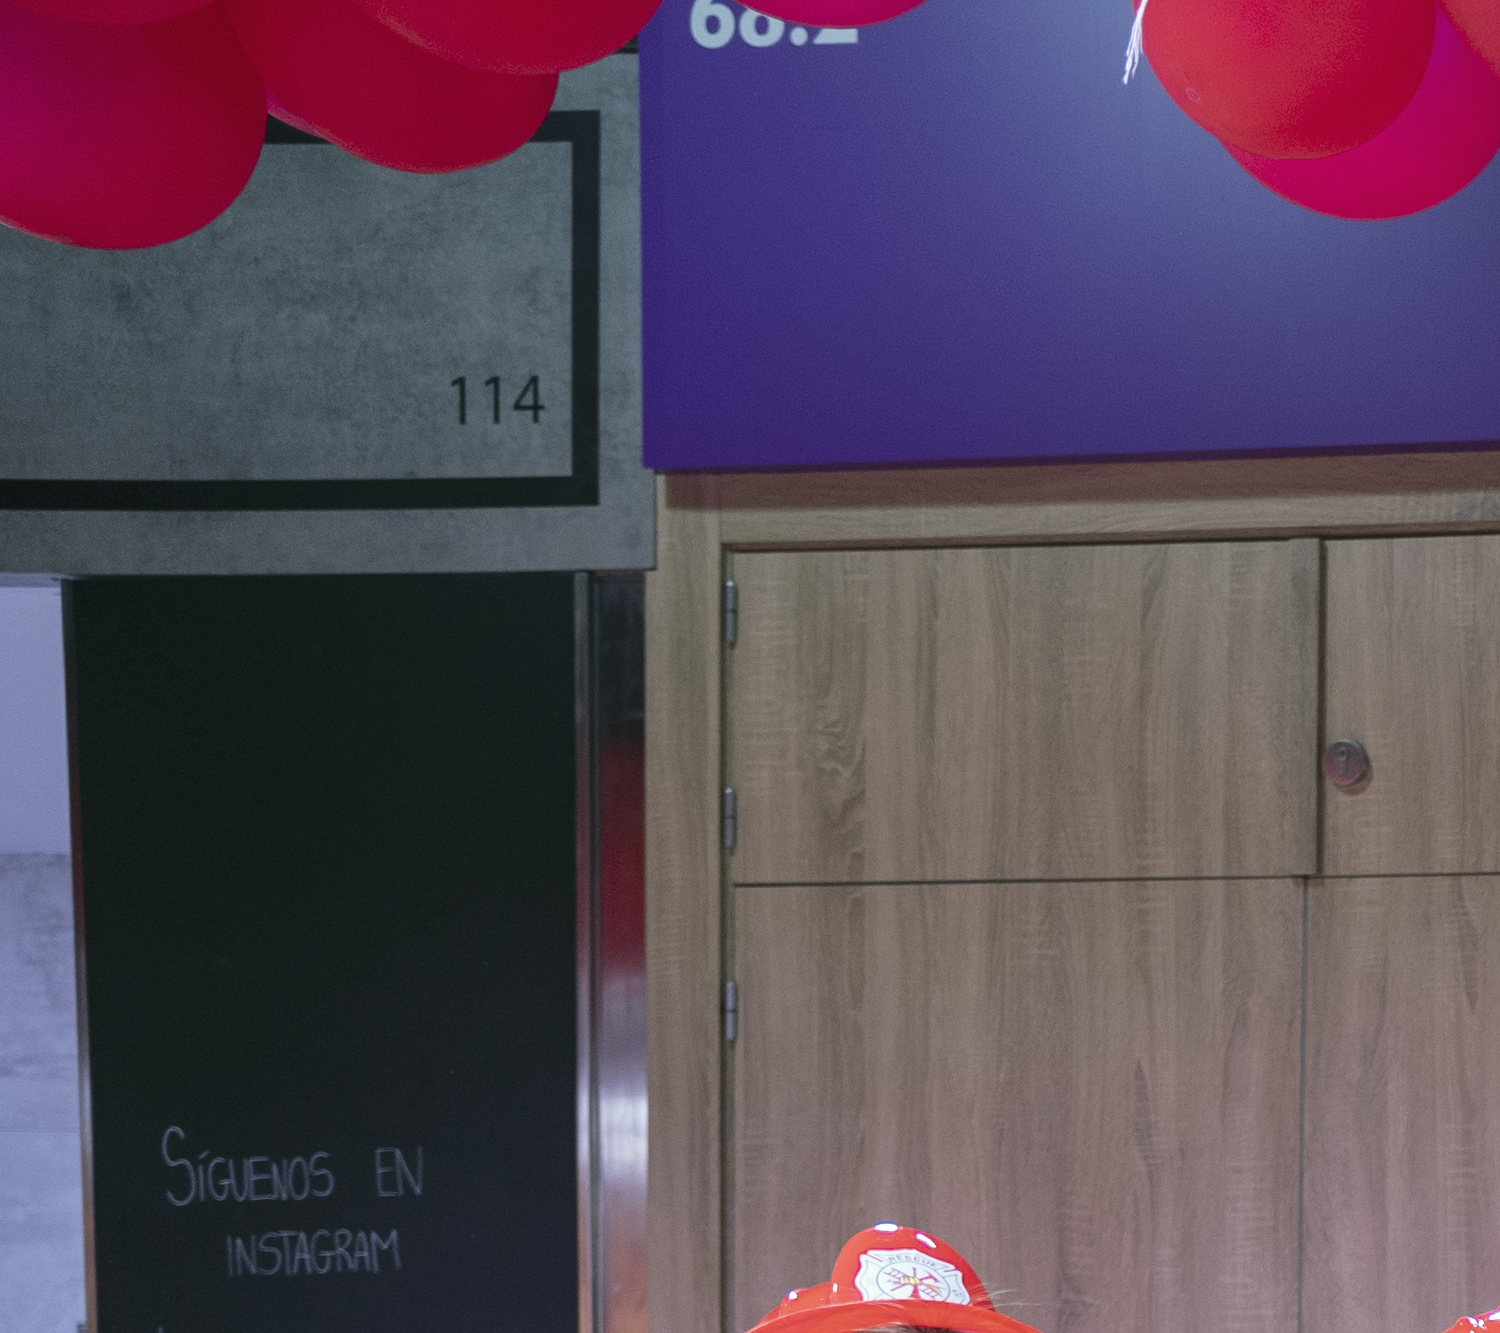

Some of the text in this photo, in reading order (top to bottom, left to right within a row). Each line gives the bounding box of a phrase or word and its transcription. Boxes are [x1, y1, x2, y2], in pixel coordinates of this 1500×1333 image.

[449, 376, 545, 424] 114
[374, 1145, 424, 1197] EN
[226, 1228, 402, 1277] INSTAGRAM
